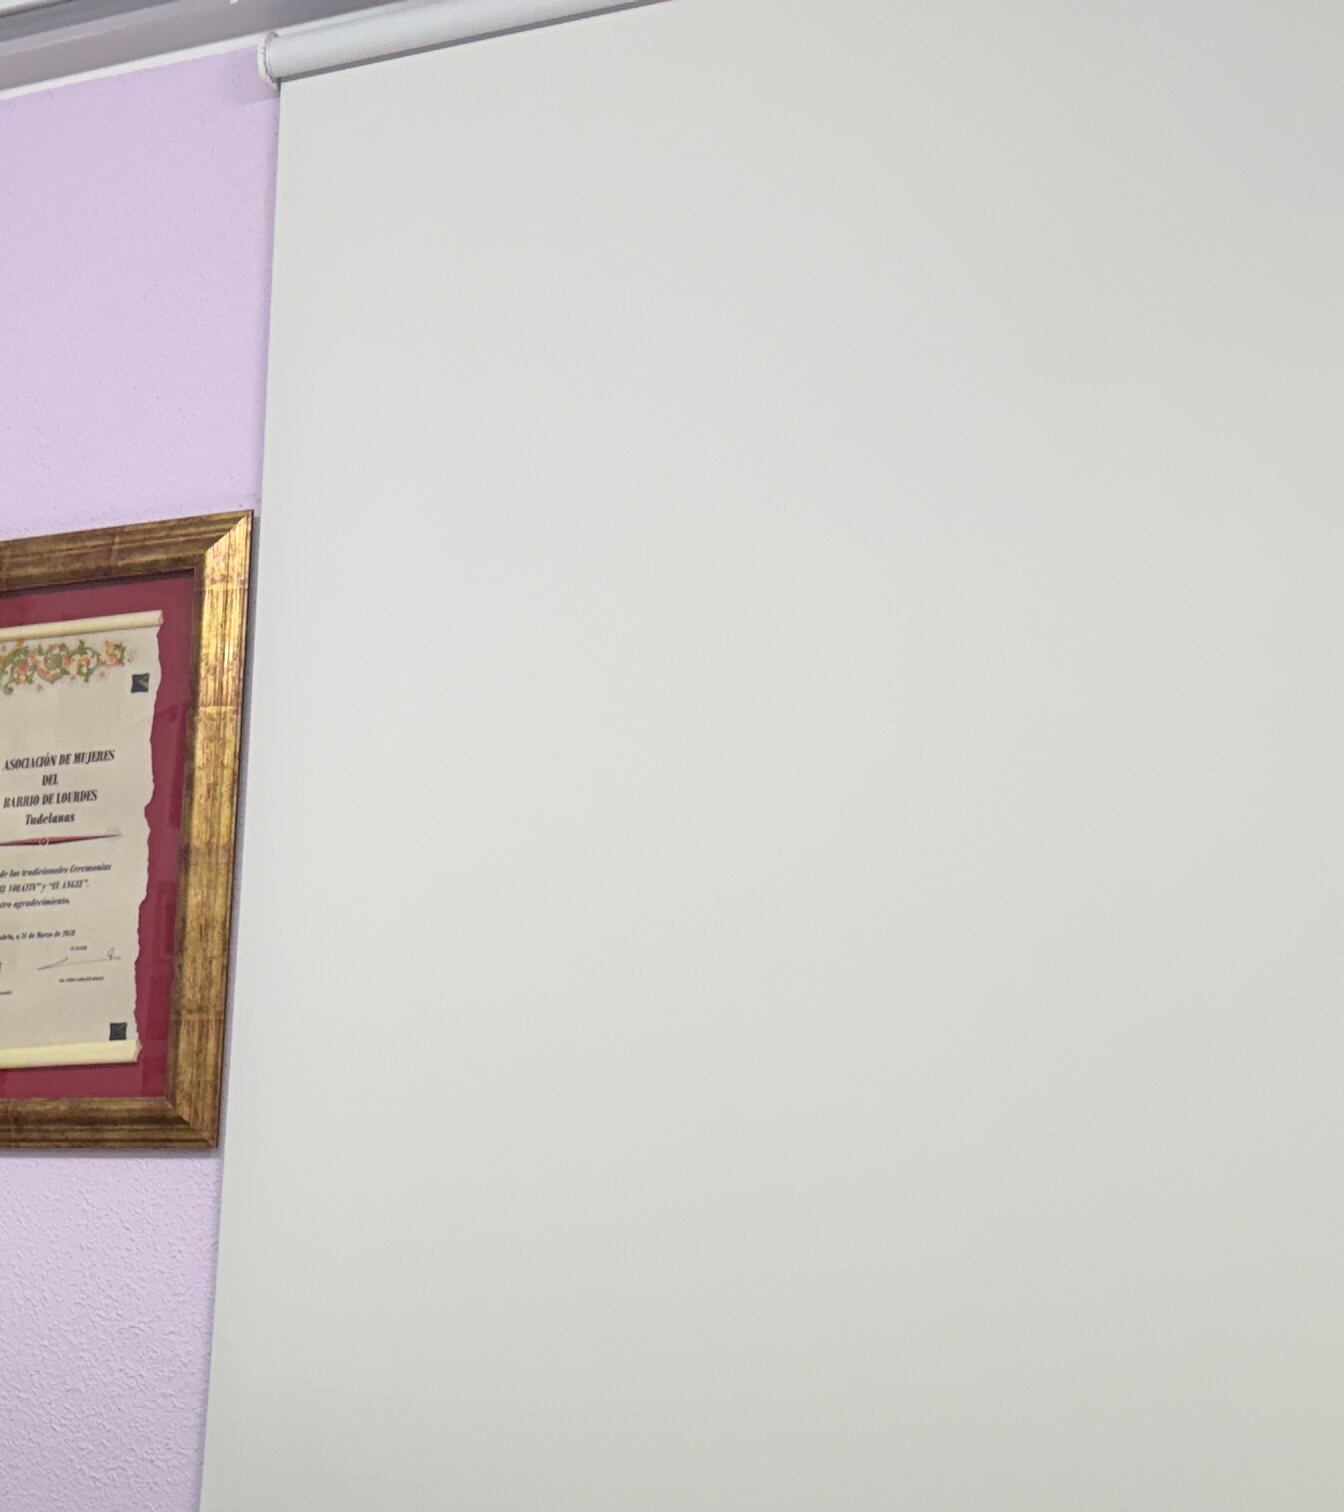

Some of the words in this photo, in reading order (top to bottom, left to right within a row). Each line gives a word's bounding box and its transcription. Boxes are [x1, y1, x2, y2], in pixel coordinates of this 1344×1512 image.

[2, 752, 56, 771] ASOCIACIÓN
[58, 752, 72, 765] DE
[72, 749, 116, 765] MUJERES
[42, 774, 59, 786] DEL
[3, 795, 40, 809] BARRIO
[42, 793, 55, 806] DE
[56, 789, 98, 804] LOURDES
[25, 812, 76, 826] Tudelanas
